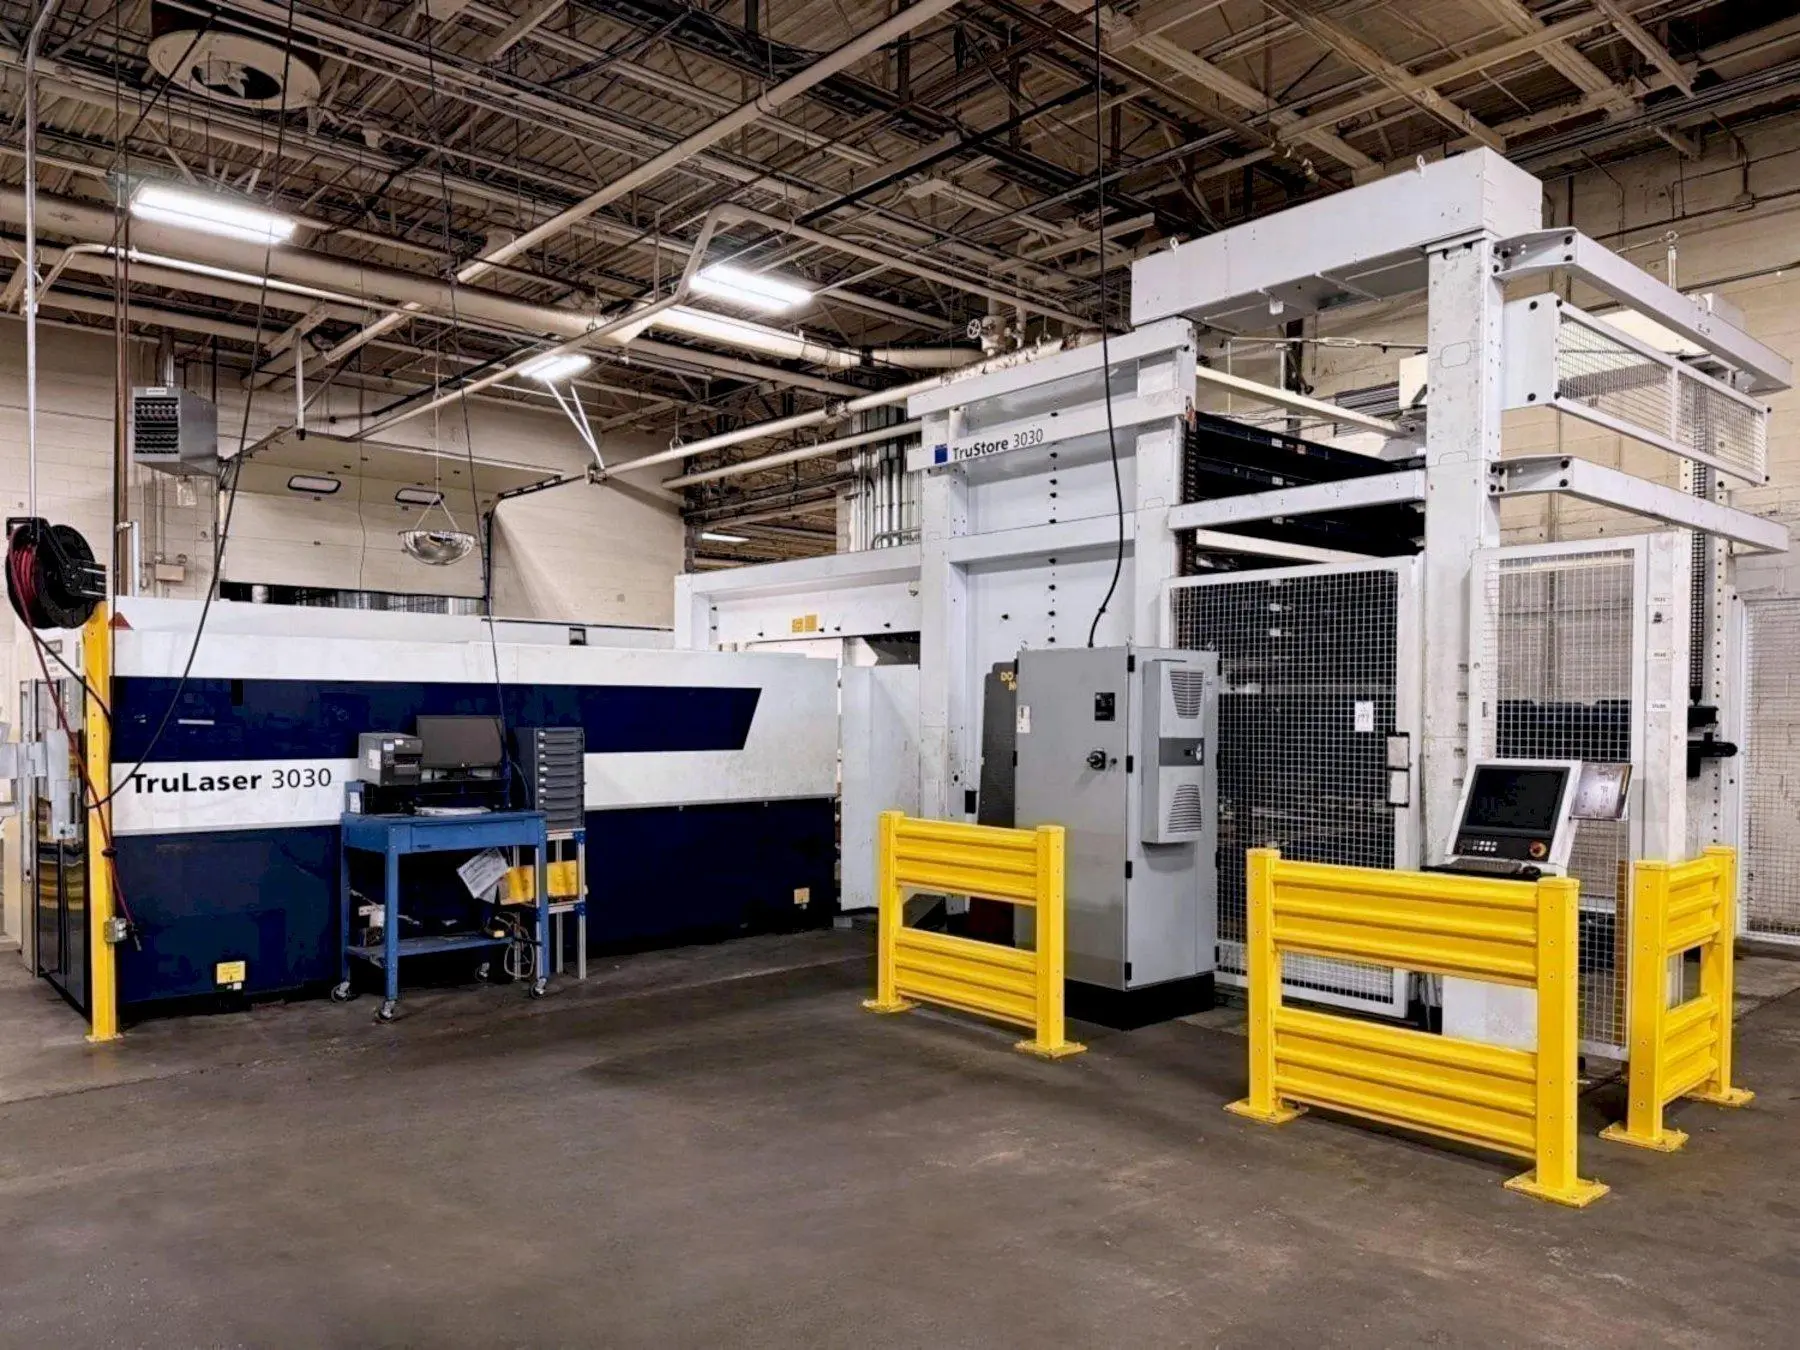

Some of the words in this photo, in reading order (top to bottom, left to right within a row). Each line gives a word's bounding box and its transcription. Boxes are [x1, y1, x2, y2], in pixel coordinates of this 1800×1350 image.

[953, 439, 1009, 460] TruStore
[1013, 428, 1044, 448] 3030
[132, 772, 262, 793] TruLaser
[271, 768, 332, 789] 3030
